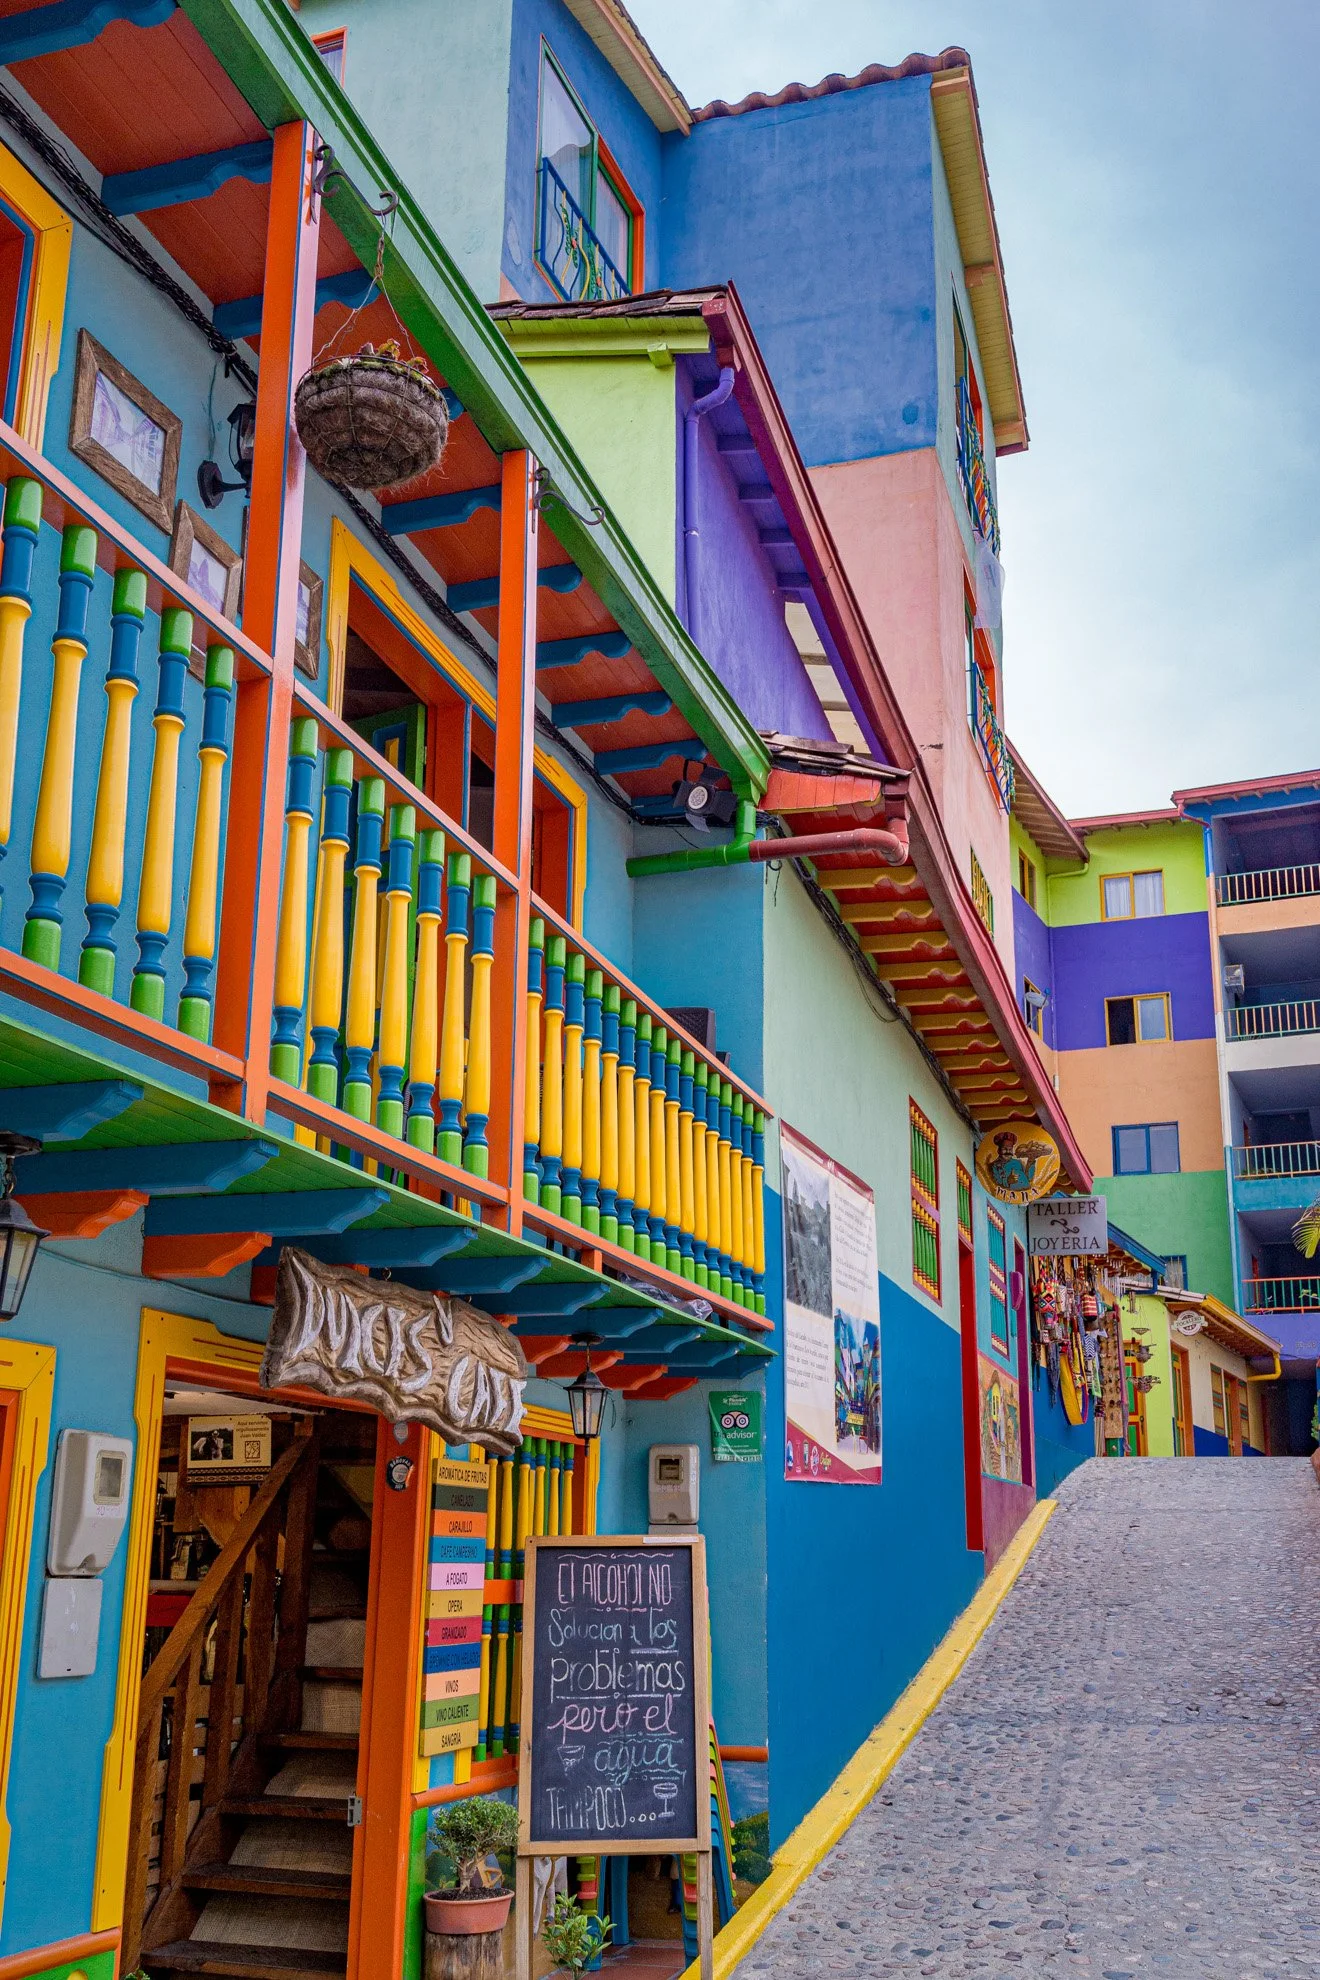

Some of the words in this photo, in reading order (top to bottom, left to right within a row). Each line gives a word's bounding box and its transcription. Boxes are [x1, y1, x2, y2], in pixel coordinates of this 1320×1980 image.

[1034, 1201, 1099, 1216] TALLER
[1031, 1236, 1101, 1253] JOYERIA
[465, 1470, 470, 1482] DE
[471, 1471, 488, 1484] FRUTAS
[448, 1520, 473, 1534] CARAJILLO
[453, 1545, 478, 1559] CAMPESINO
[648, 1563, 673, 1606] NO
[447, 1599, 463, 1613] OPERA
[441, 1625, 467, 1640] GRANIZADO
[649, 1606, 677, 1649] los
[445, 1680, 459, 1693] VINOS
[436, 1708, 447, 1723] VINO
[447, 1704, 469, 1721] CALIENTE
[547, 1702, 638, 1745] pero
[642, 1693, 678, 1735] el
[441, 1730, 462, 1748] SANGRÍA
[594, 1743, 678, 1785] agua
